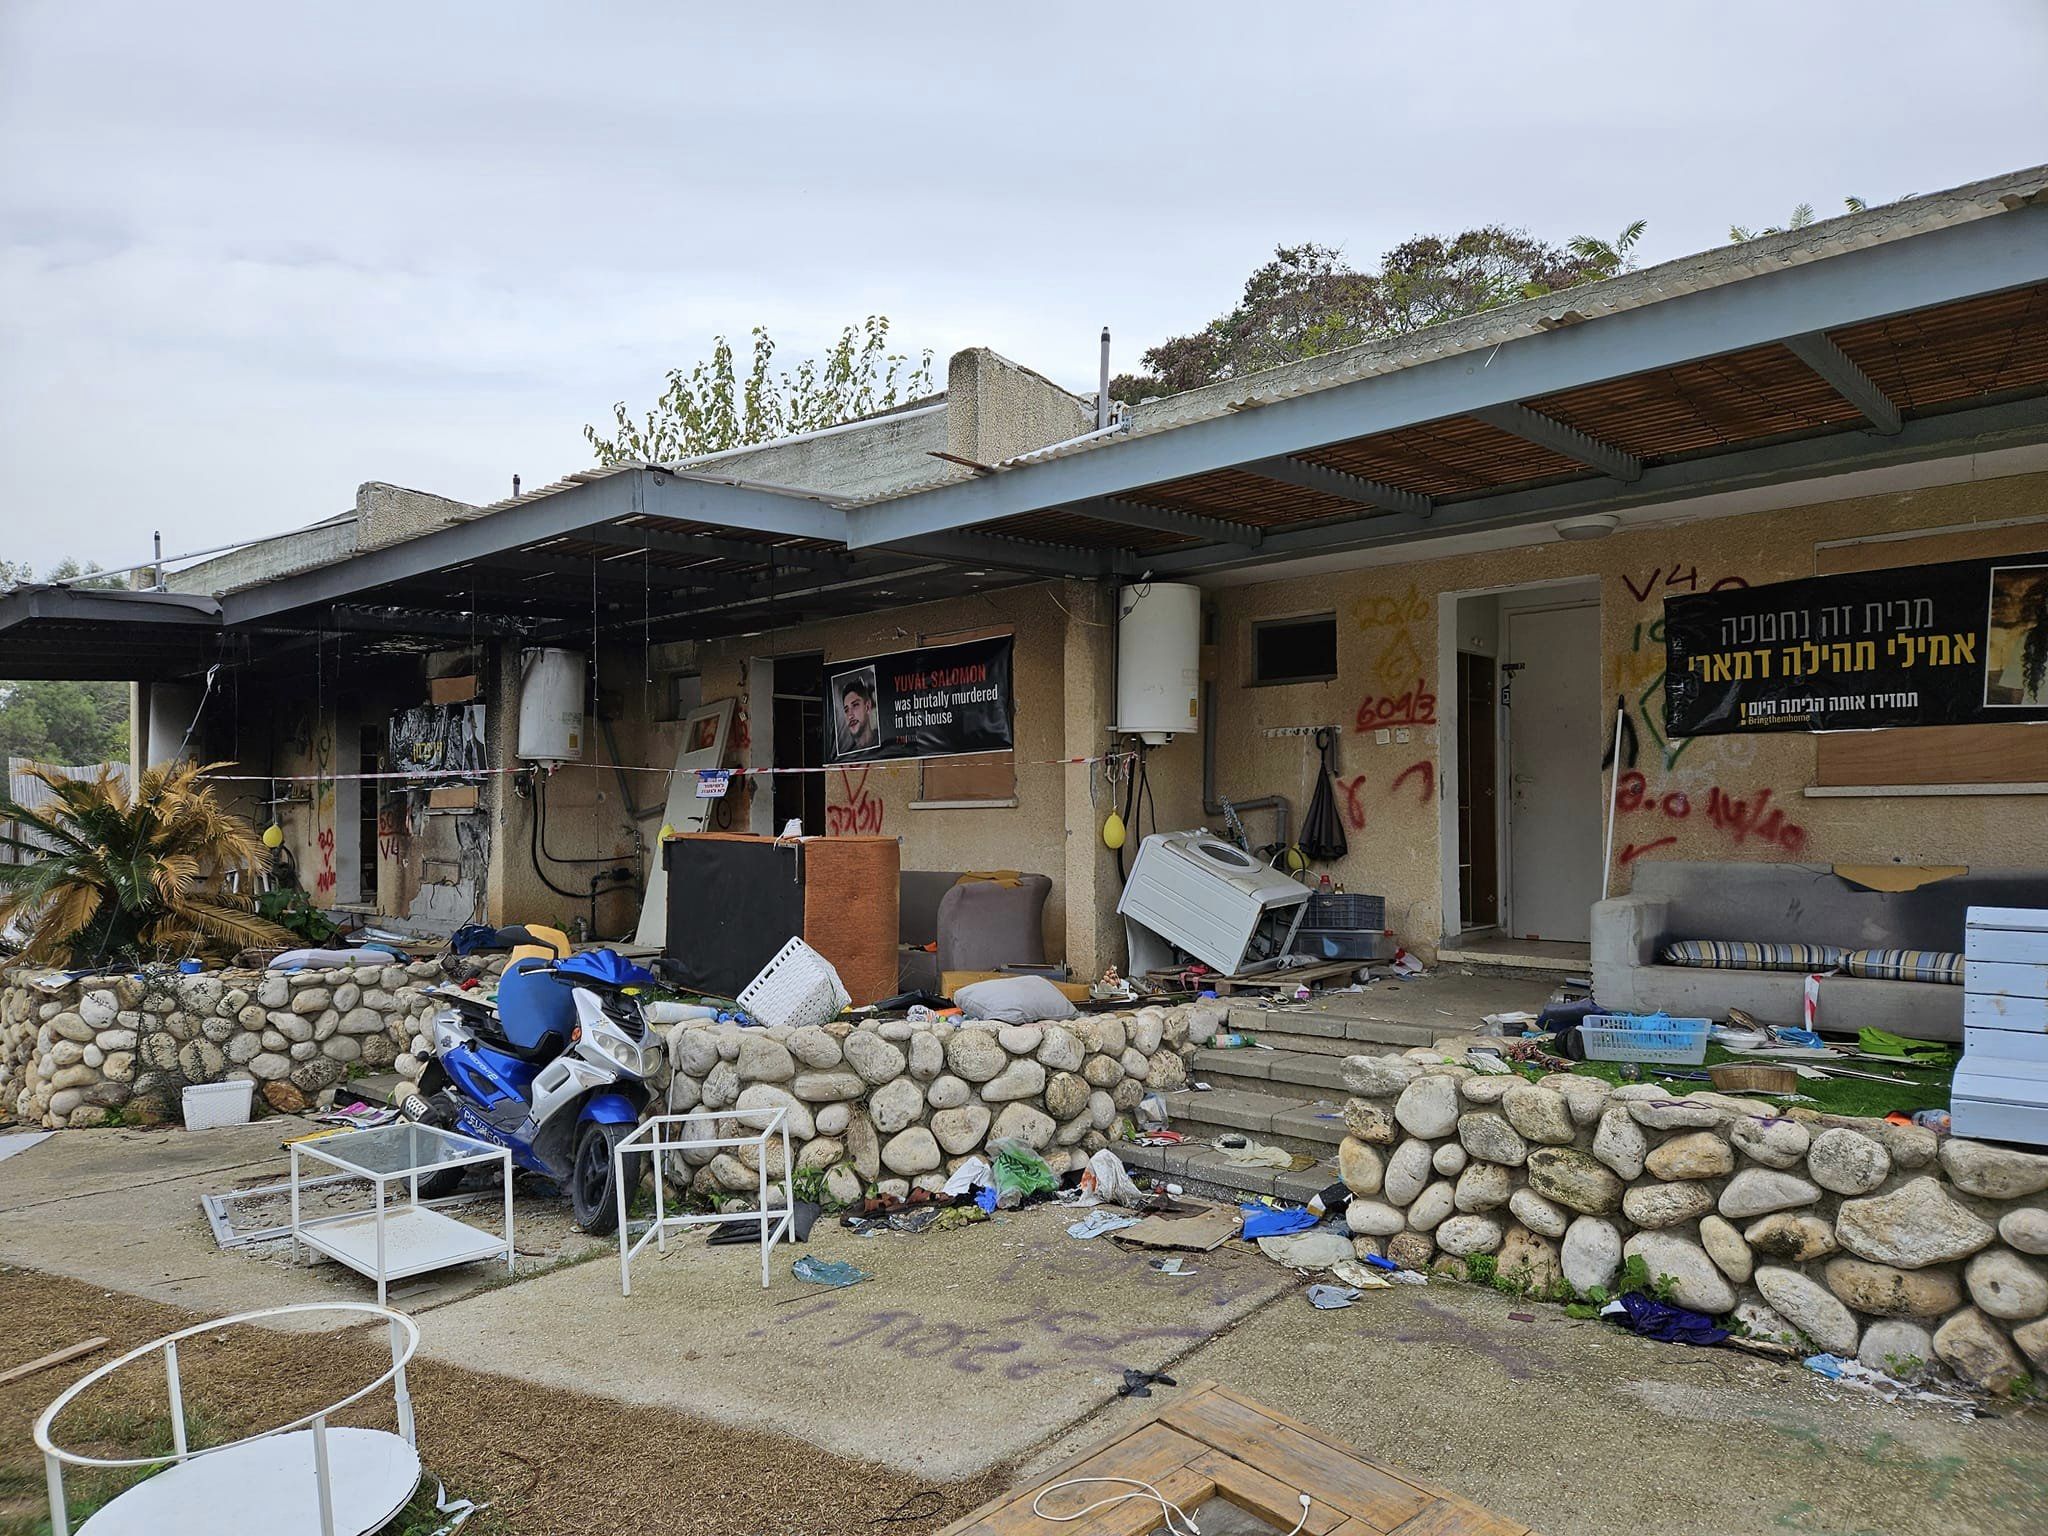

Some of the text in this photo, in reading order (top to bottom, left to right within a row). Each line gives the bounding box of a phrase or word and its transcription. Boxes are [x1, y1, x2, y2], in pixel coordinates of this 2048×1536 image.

[1721, 598, 1934, 646] מבית זה נחטפה
[1688, 631, 1976, 683] אמילי תהילה דמארי
[894, 663, 986, 693] YUVAL SALOMON
[894, 683, 998, 712] was brutally murdered
[1781, 697, 1825, 714] הביתה
[1829, 694, 1866, 712] אותה
[1870, 691, 1918, 710] תחזירו
[895, 710, 953, 729] in this house
[1748, 714, 1811, 726] Bringthemhome
